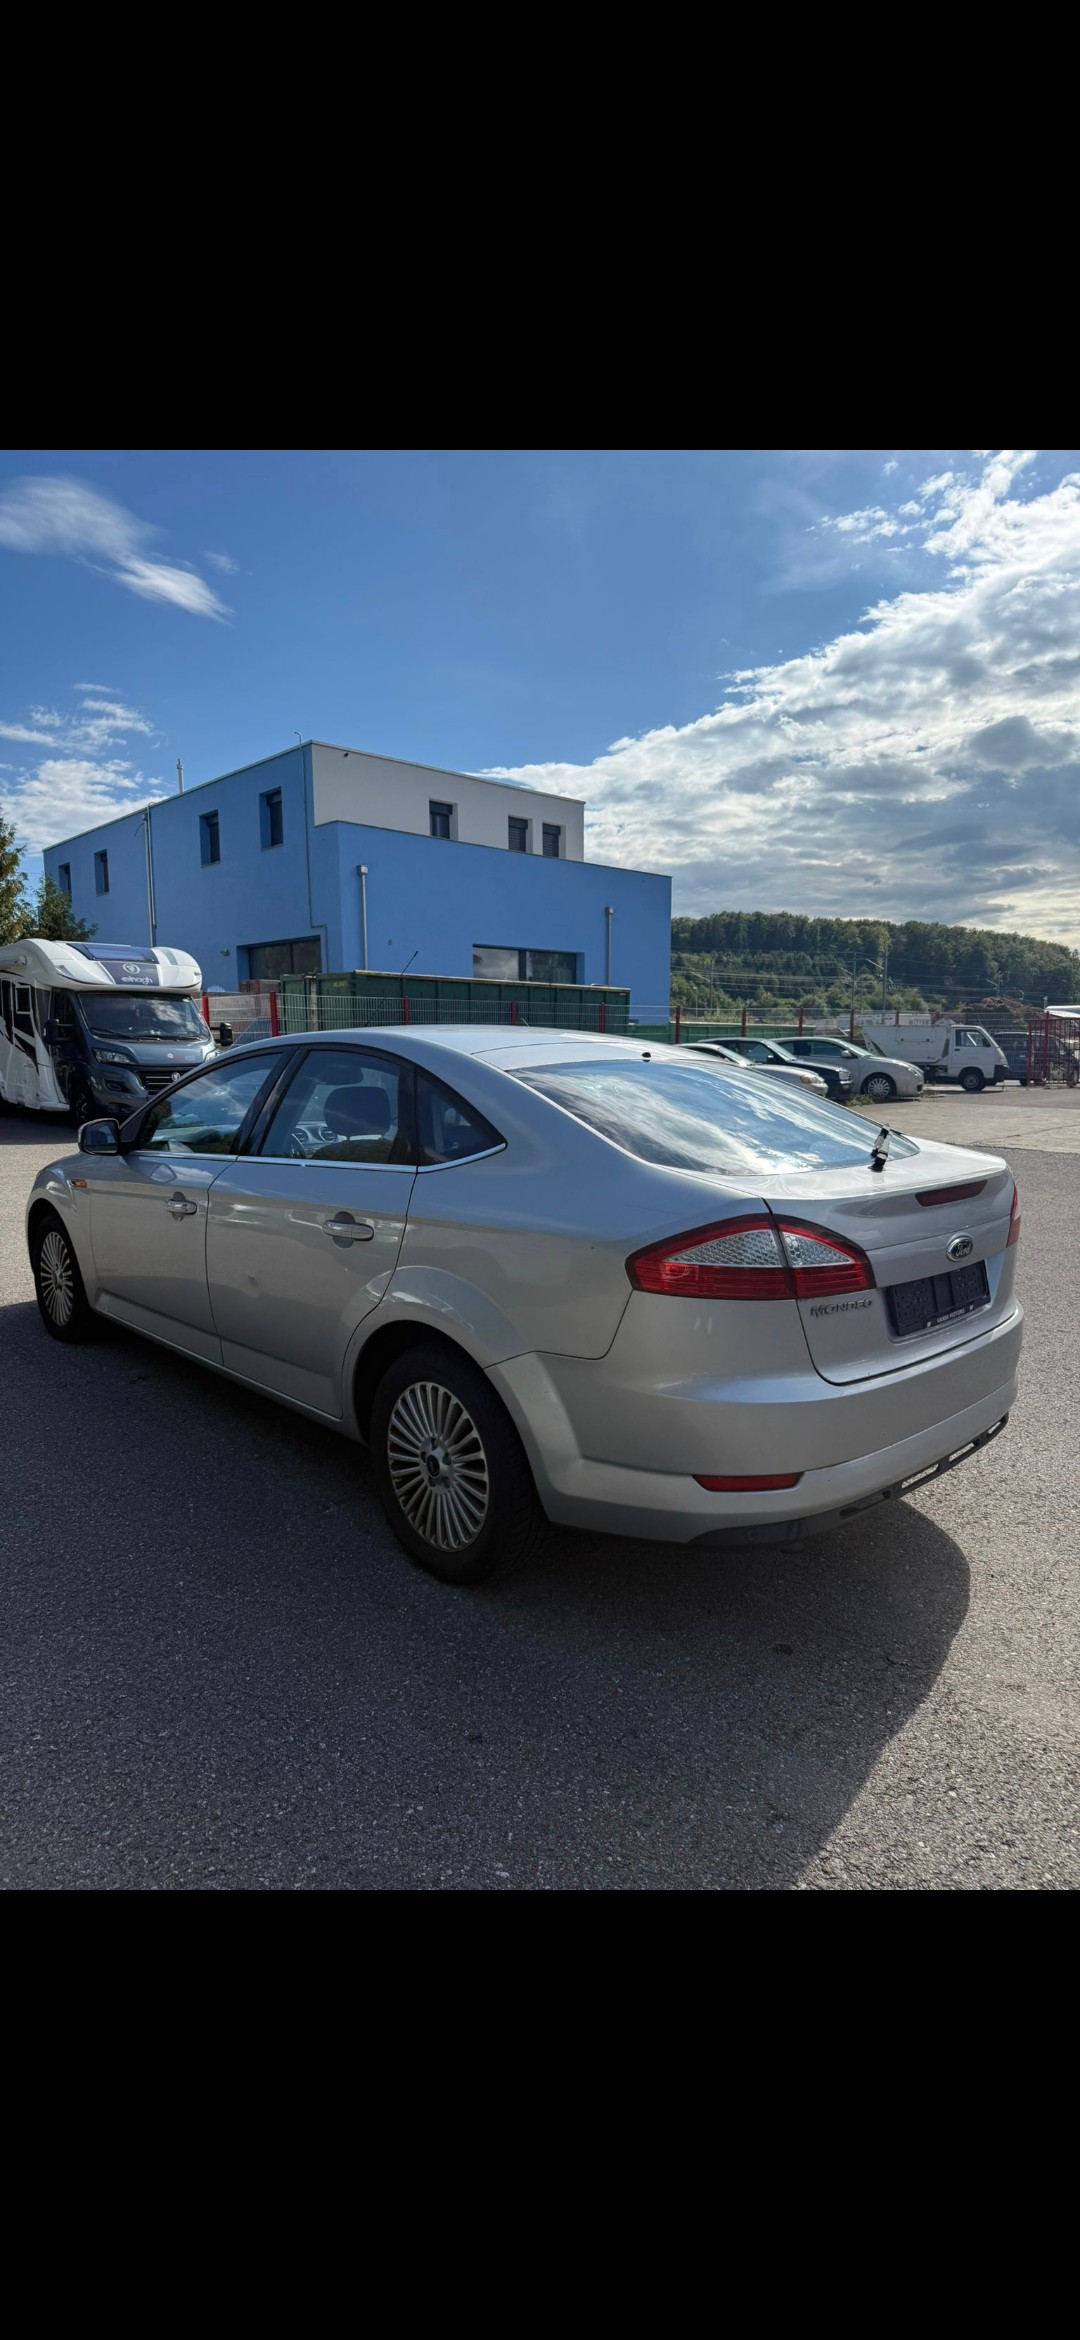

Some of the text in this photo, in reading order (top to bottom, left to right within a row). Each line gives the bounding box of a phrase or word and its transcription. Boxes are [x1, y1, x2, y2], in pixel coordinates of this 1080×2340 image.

[121, 976, 153, 985] elnagh
[955, 1240, 972, 1257] Ford
[810, 1298, 873, 1319] MONDEO
